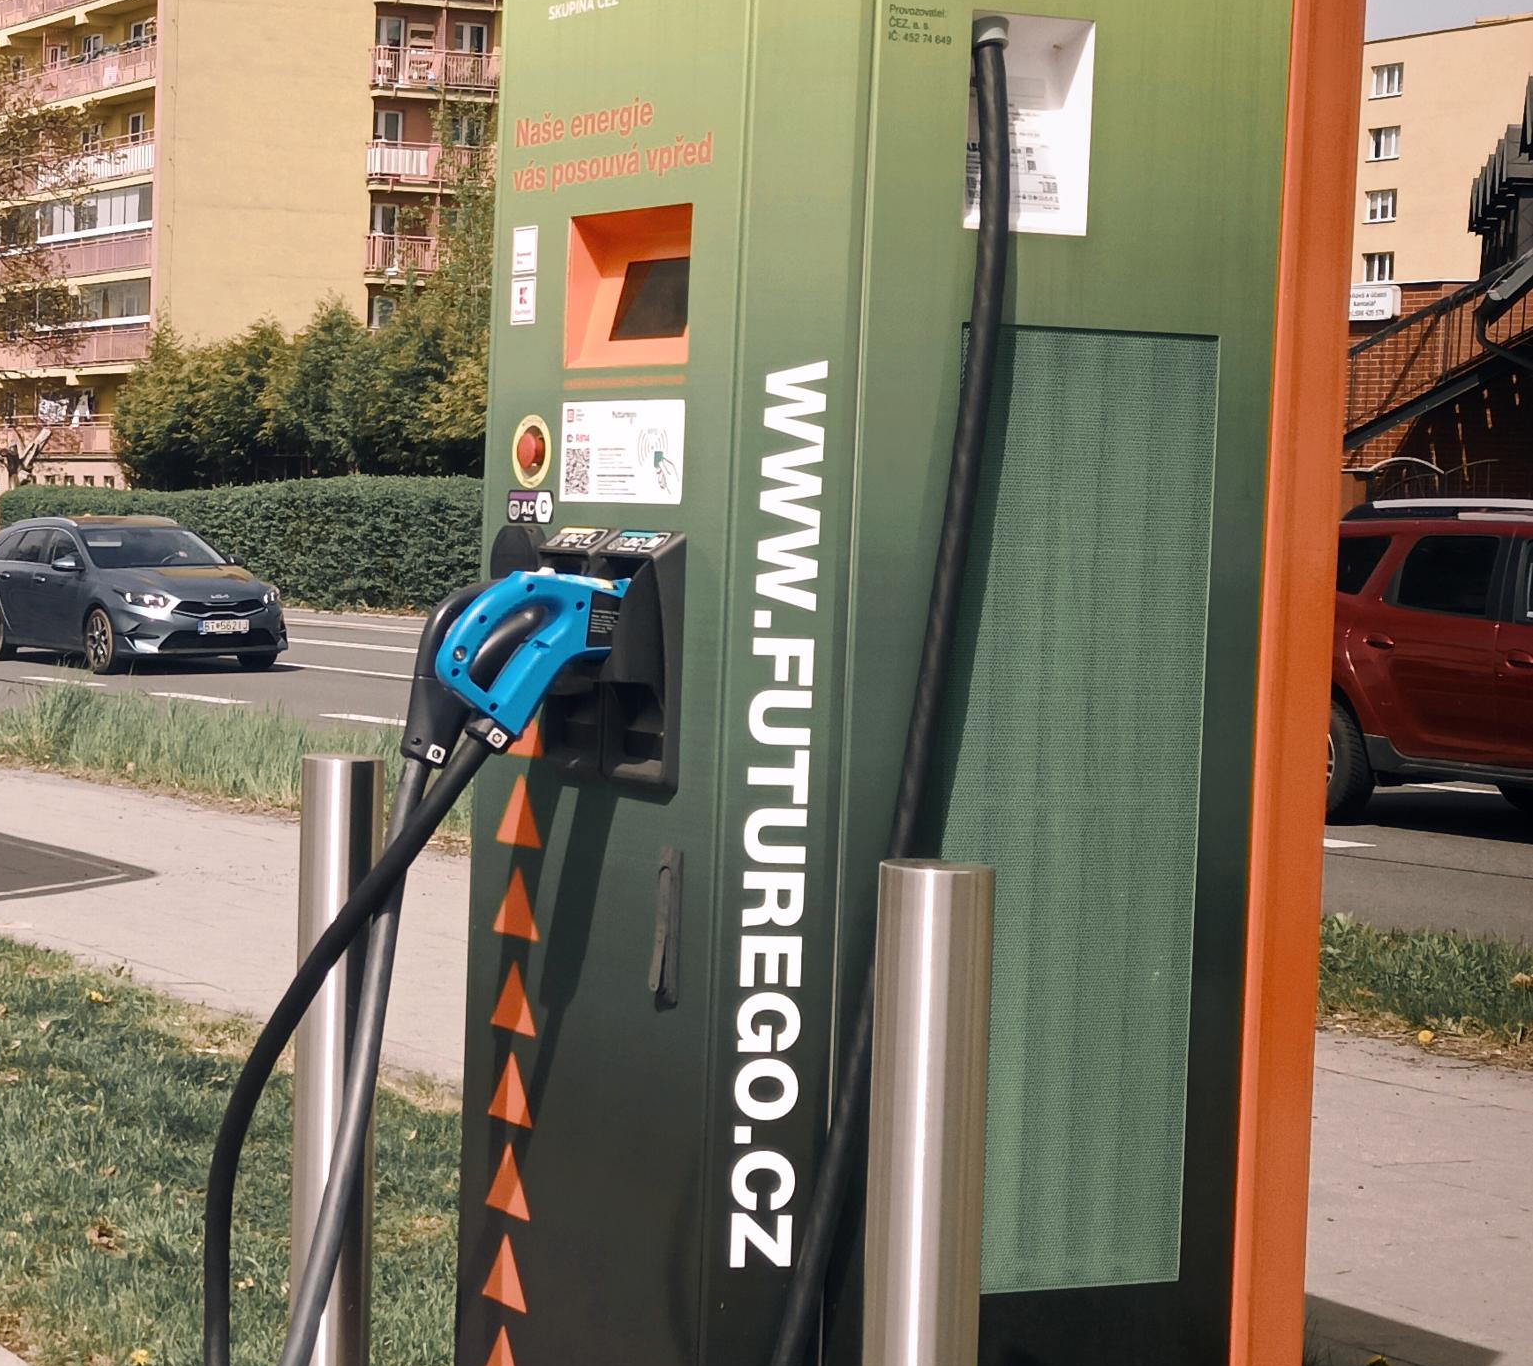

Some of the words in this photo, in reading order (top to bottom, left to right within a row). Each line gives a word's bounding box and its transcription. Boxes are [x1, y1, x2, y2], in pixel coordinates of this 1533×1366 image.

[516, 112, 564, 147] Naše
[570, 97, 654, 138] energie
[513, 160, 546, 191] vás
[551, 143, 640, 193] posouvá
[645, 132, 713, 178] vpřed
[521, 500, 535, 515] AC
[540, 499, 548, 515] C
[729, 360, 829, 1269] WWW.FUTUREGO.CZ
